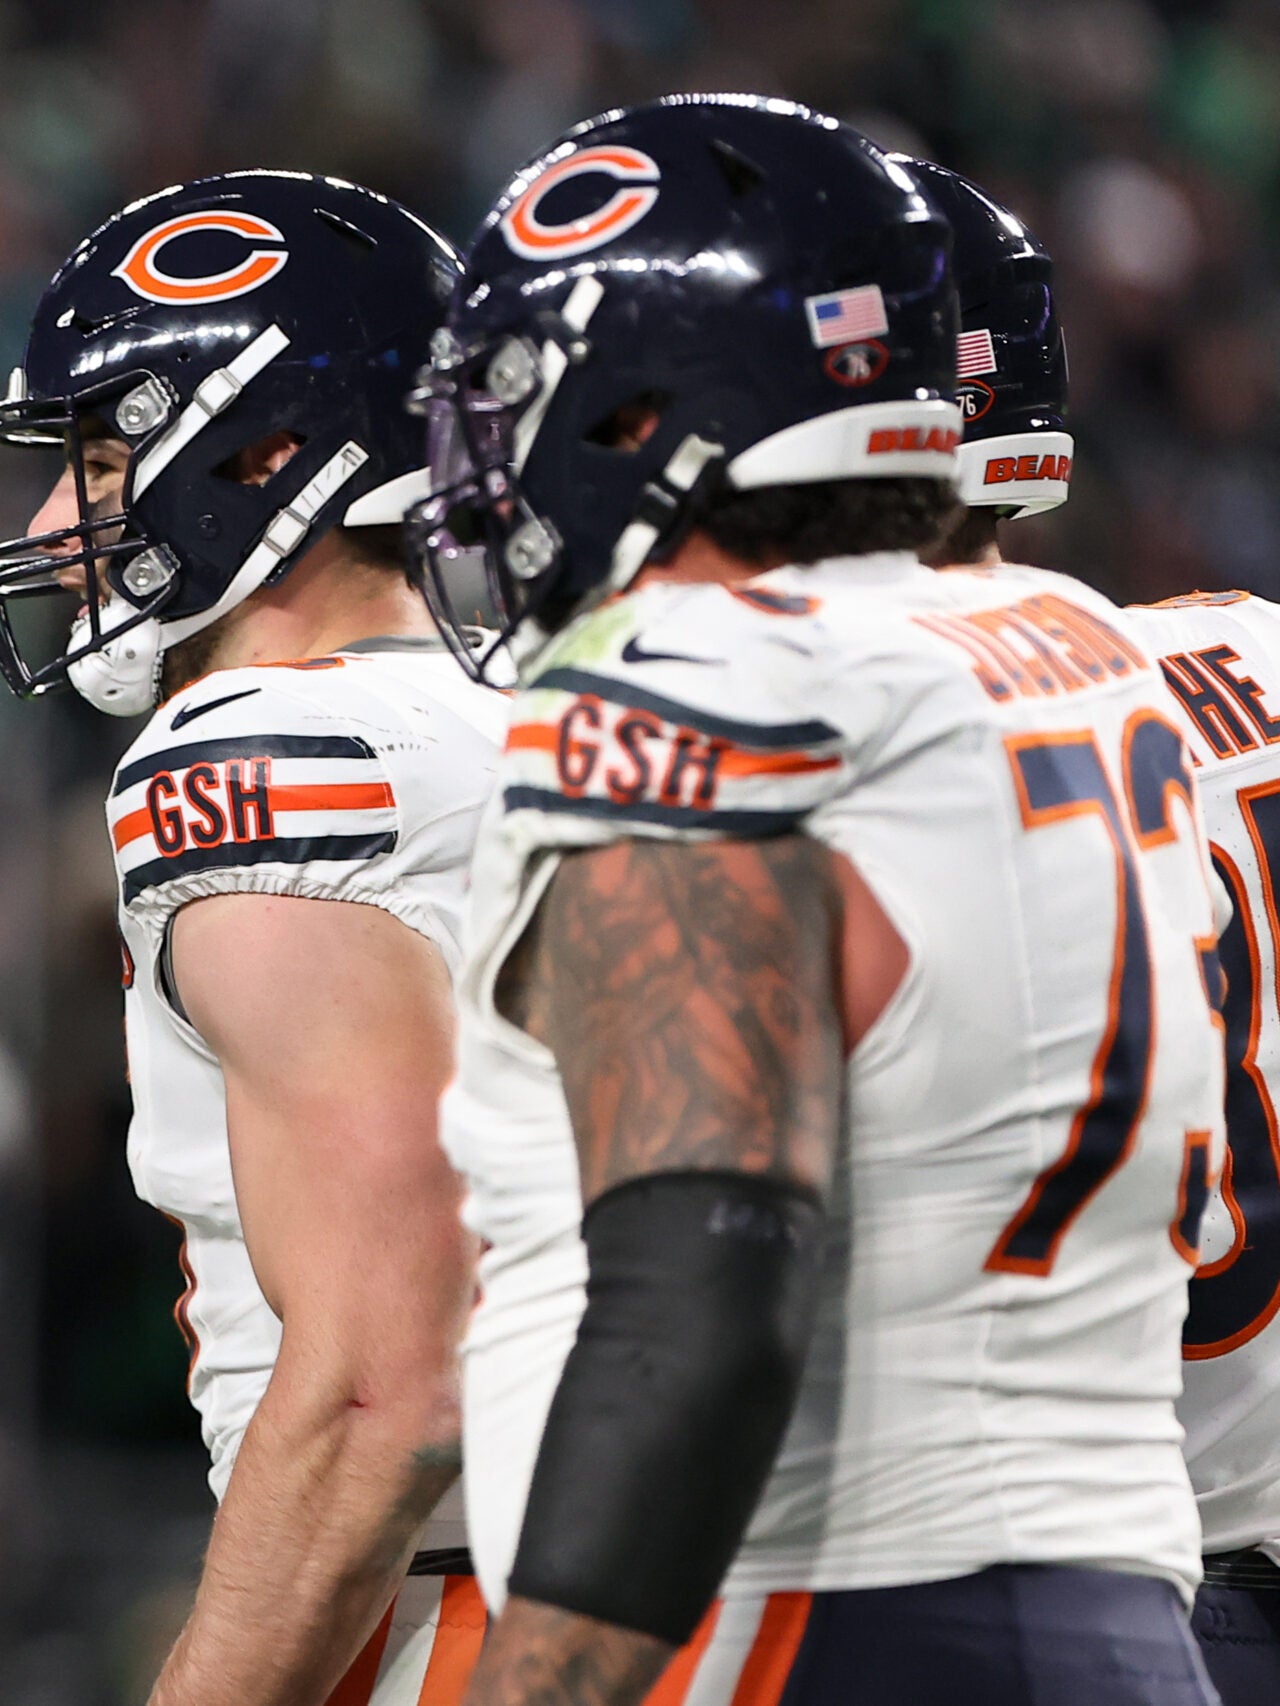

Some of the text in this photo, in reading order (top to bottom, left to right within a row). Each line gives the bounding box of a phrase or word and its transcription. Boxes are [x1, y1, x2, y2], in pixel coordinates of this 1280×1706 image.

[955, 394, 977, 416] 76
[555, 692, 732, 812] GSH
[146, 756, 276, 859] GSH
